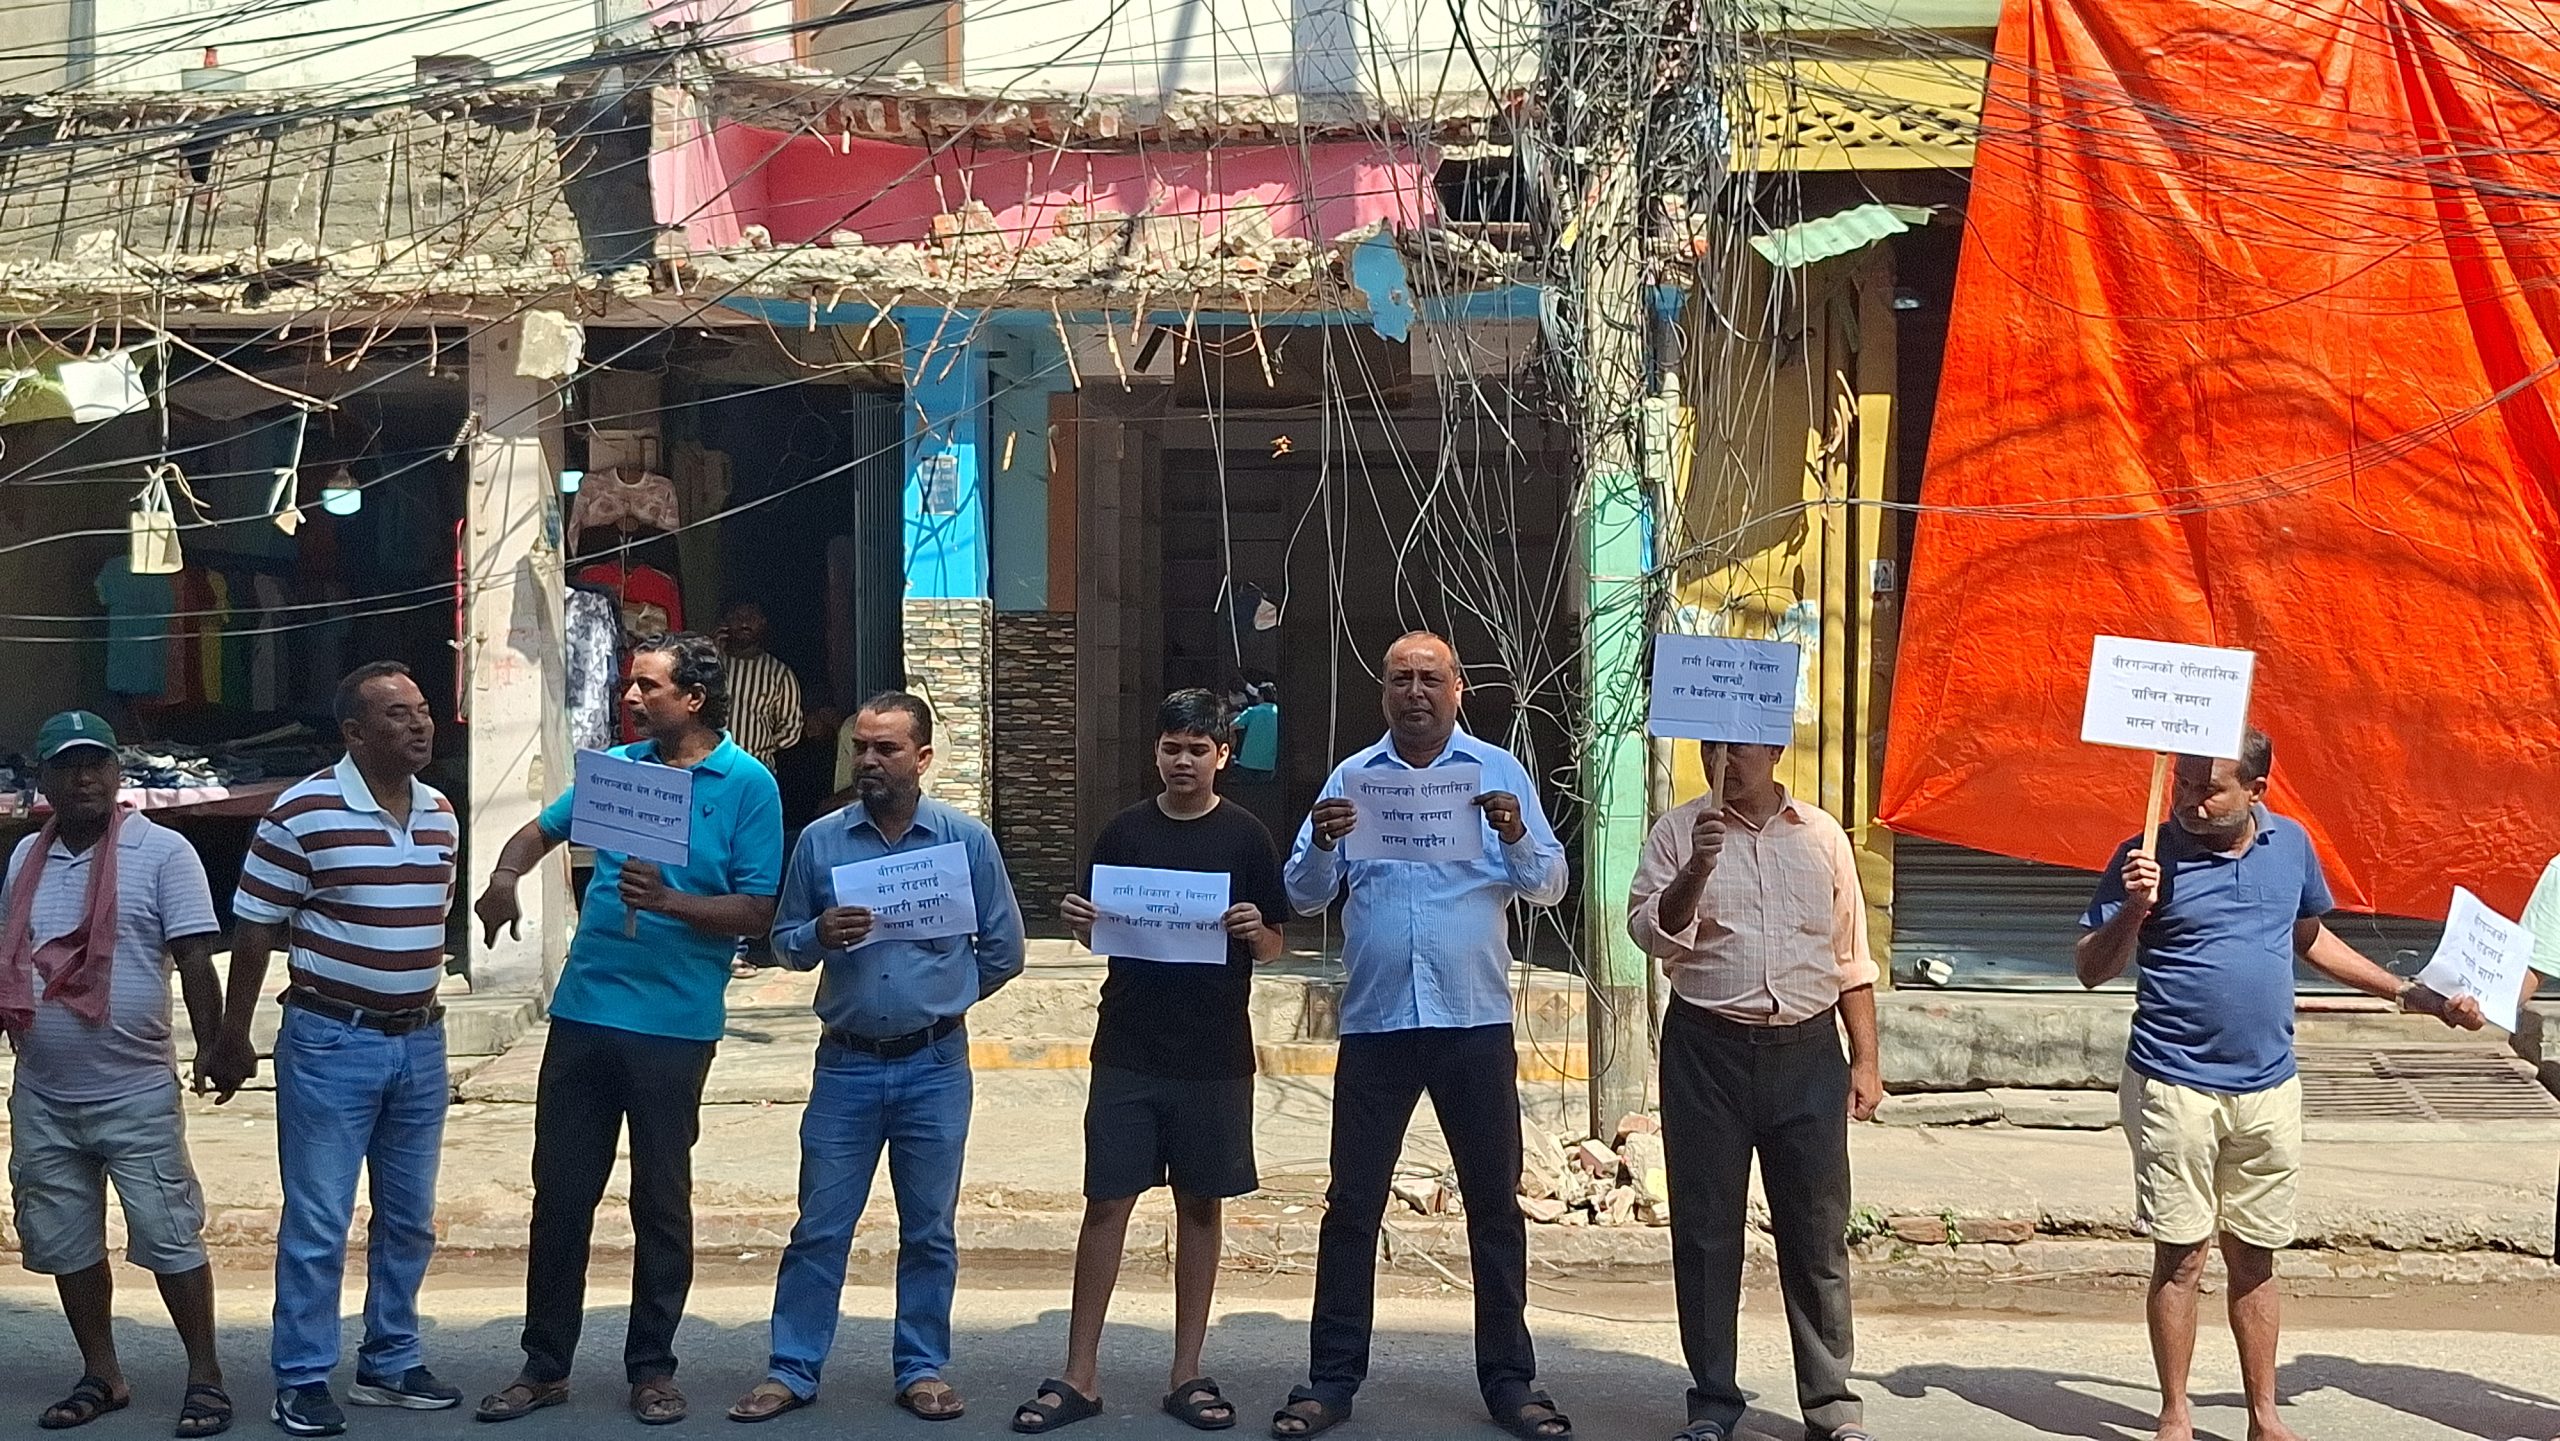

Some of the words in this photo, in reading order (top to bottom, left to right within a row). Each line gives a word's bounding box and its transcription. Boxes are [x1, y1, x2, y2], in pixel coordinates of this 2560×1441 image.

[2180, 662, 2239, 681] ऐतिहासिक
[1673, 686, 1685, 696] तर
[1421, 781, 1473, 798] ऐतिहासिक
[1419, 810, 1452, 822] सम्पदा
[920, 916, 934, 926] गर
